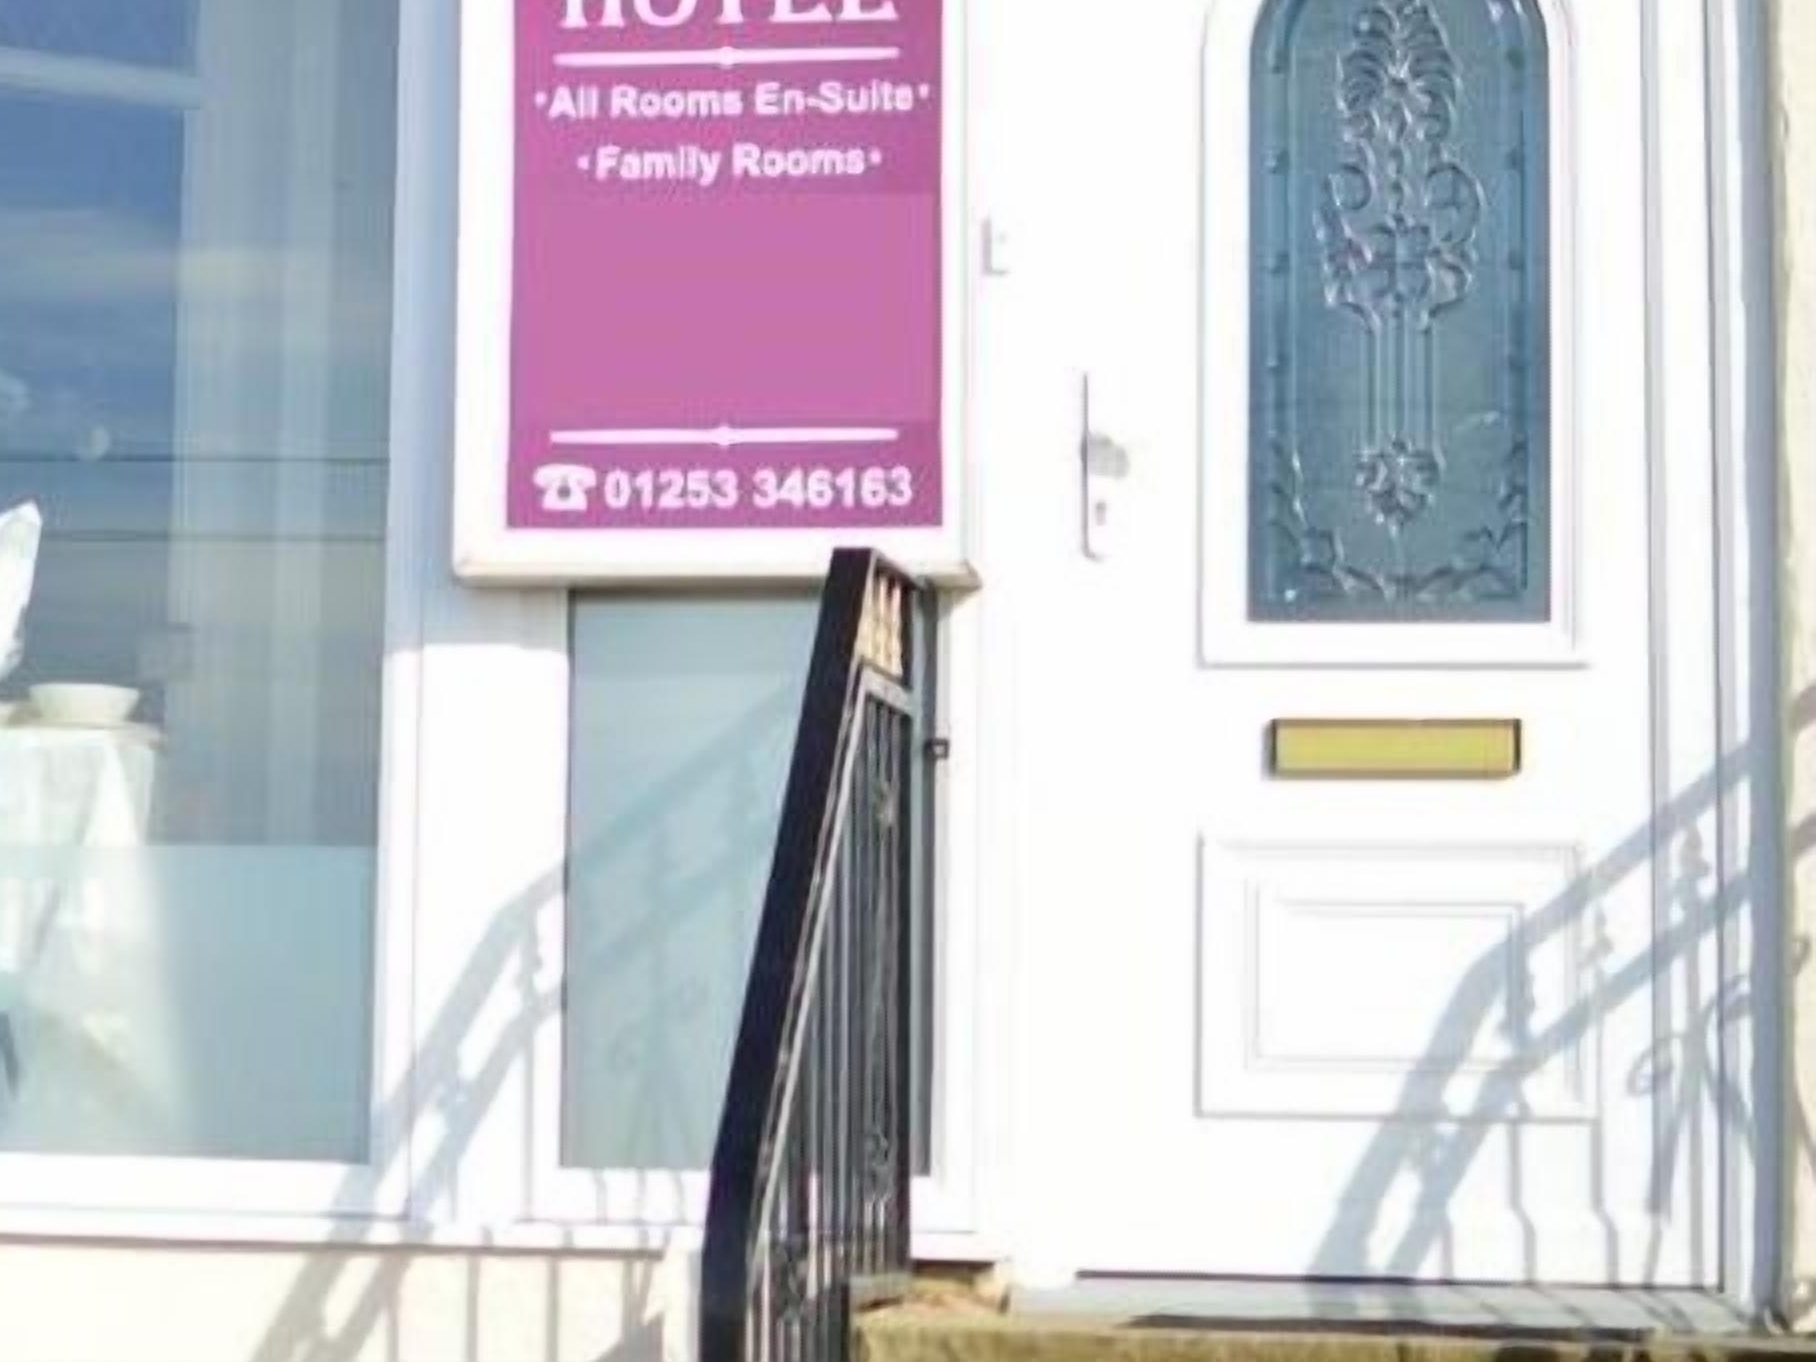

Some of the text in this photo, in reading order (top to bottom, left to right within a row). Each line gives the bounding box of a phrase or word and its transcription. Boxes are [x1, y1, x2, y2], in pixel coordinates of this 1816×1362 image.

[610, 84, 744, 119] Rooms
[595, 141, 866, 187] Family Rooms
[603, 465, 915, 510] 01253 346163
